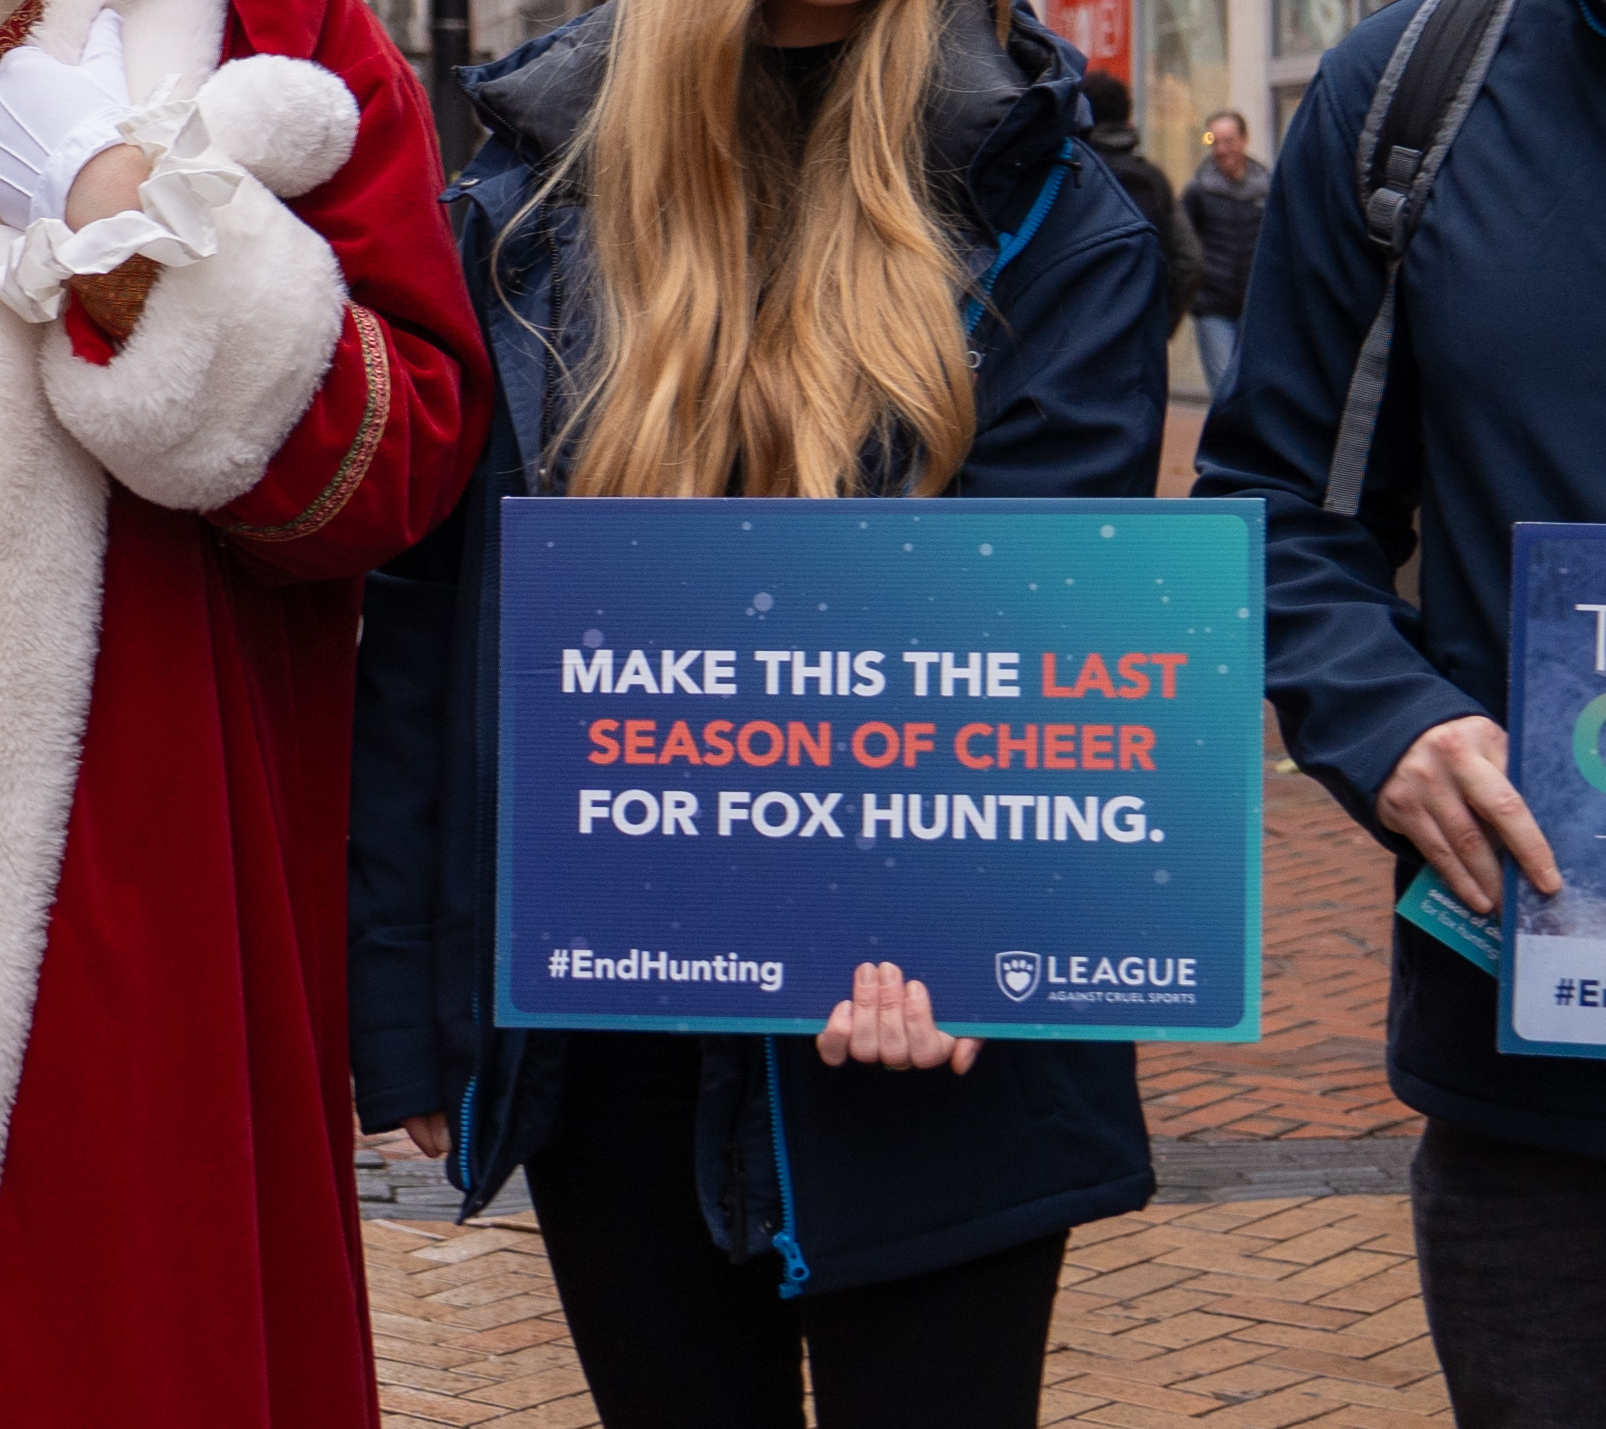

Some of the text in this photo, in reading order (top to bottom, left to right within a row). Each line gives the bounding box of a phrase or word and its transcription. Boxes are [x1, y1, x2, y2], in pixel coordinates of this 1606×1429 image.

[560, 647, 1189, 701] MAKE THIS THE LAST
[586, 718, 1158, 772] SEASON OF CHEER
[577, 789, 1165, 843] FOR FOX HUNTING.
[547, 948, 785, 993] #EndHunting
[1047, 955, 1197, 987] LEAGUE
[1047, 990, 1196, 1004] AGAINST CRUEL SPORTS
